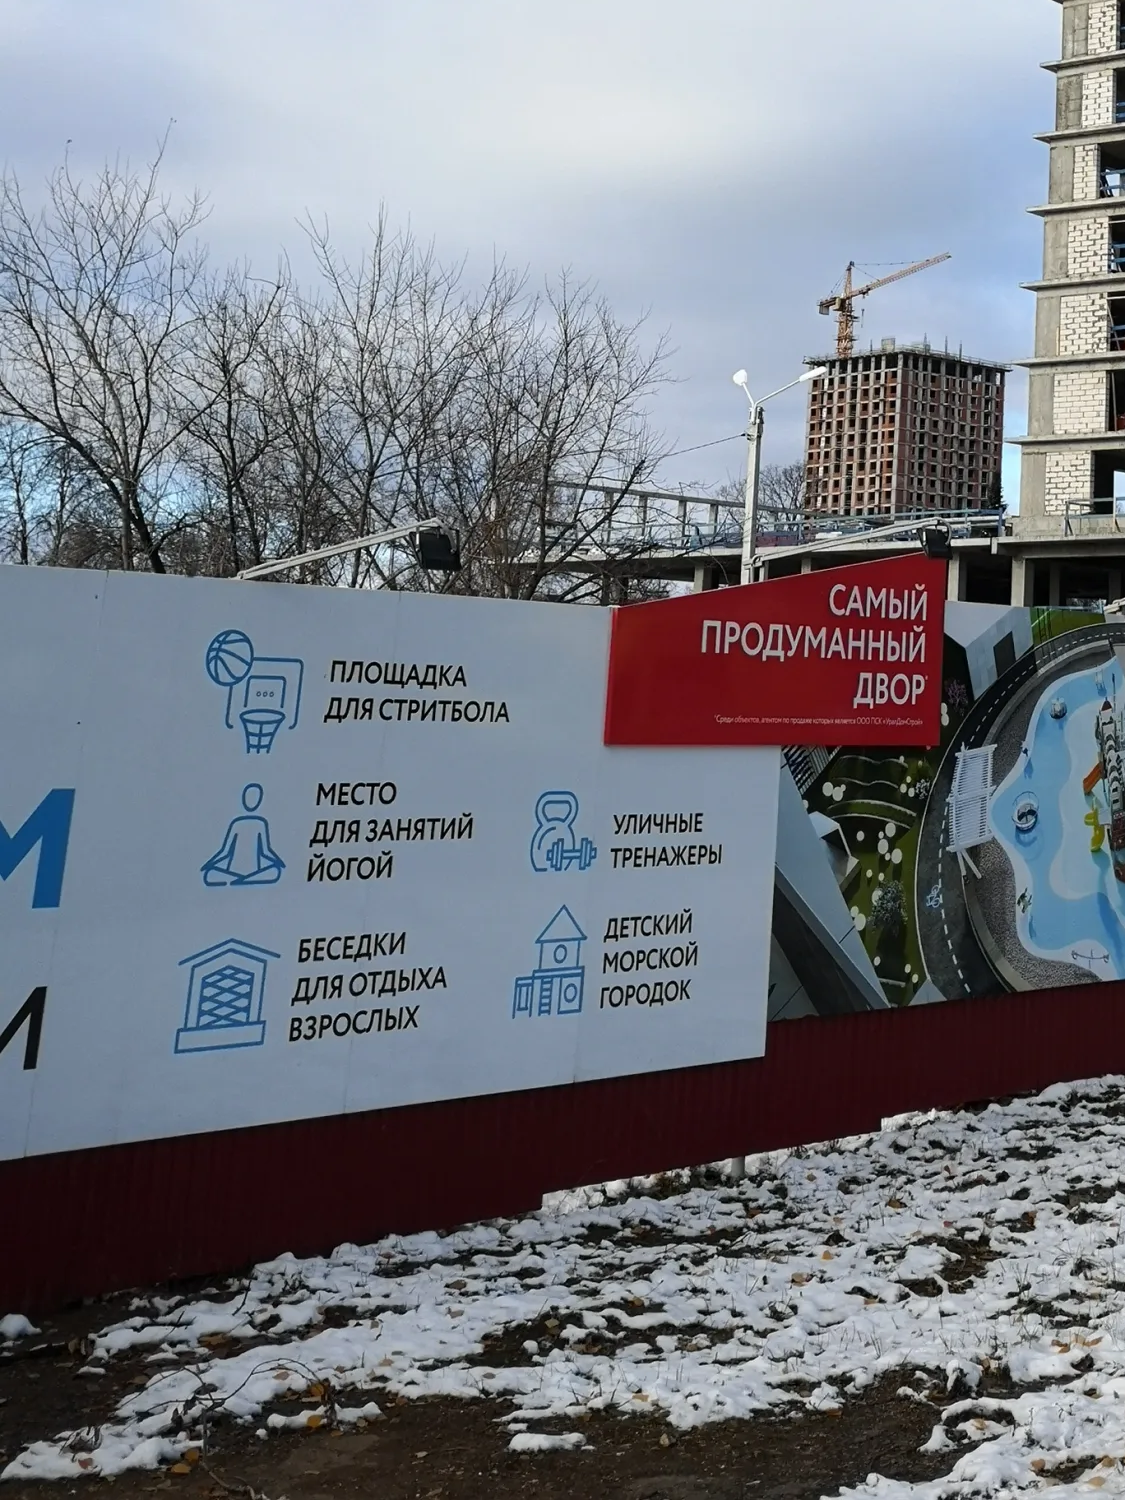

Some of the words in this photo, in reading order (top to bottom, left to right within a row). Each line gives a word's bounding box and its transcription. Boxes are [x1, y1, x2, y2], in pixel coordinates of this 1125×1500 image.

[829, 583, 928, 621] САМЫЙ
[701, 619, 926, 663] ПРОДУМАННЫЙ
[330, 660, 467, 690] ПЛОЩАДКА
[323, 697, 374, 723] ДЛЯ
[379, 698, 510, 723] СТРИТБОЛА
[856, 717, 870, 725] ООО
[316, 782, 397, 806] МЕСТО
[309, 819, 361, 848] ДЛЯ
[365, 812, 474, 843] ЗАНЯТИЙ
[613, 812, 704, 835] УЛИЧНЫЕ
[307, 850, 394, 882] ЙОГОЙ
[610, 843, 723, 869] ТРЕНАЖЕРЫ
[603, 908, 693, 943] ДЕТСКИЙ
[297, 931, 407, 963] БЕСЕДКИ
[602, 940, 699, 974] МОРСКОЙ
[290, 974, 344, 1007] ДЛЯ
[348, 966, 448, 998] ОТДЫХА
[599, 978, 692, 1009] ГОРОДОК
[288, 1004, 421, 1042] ВЗРОСЛЫХ
